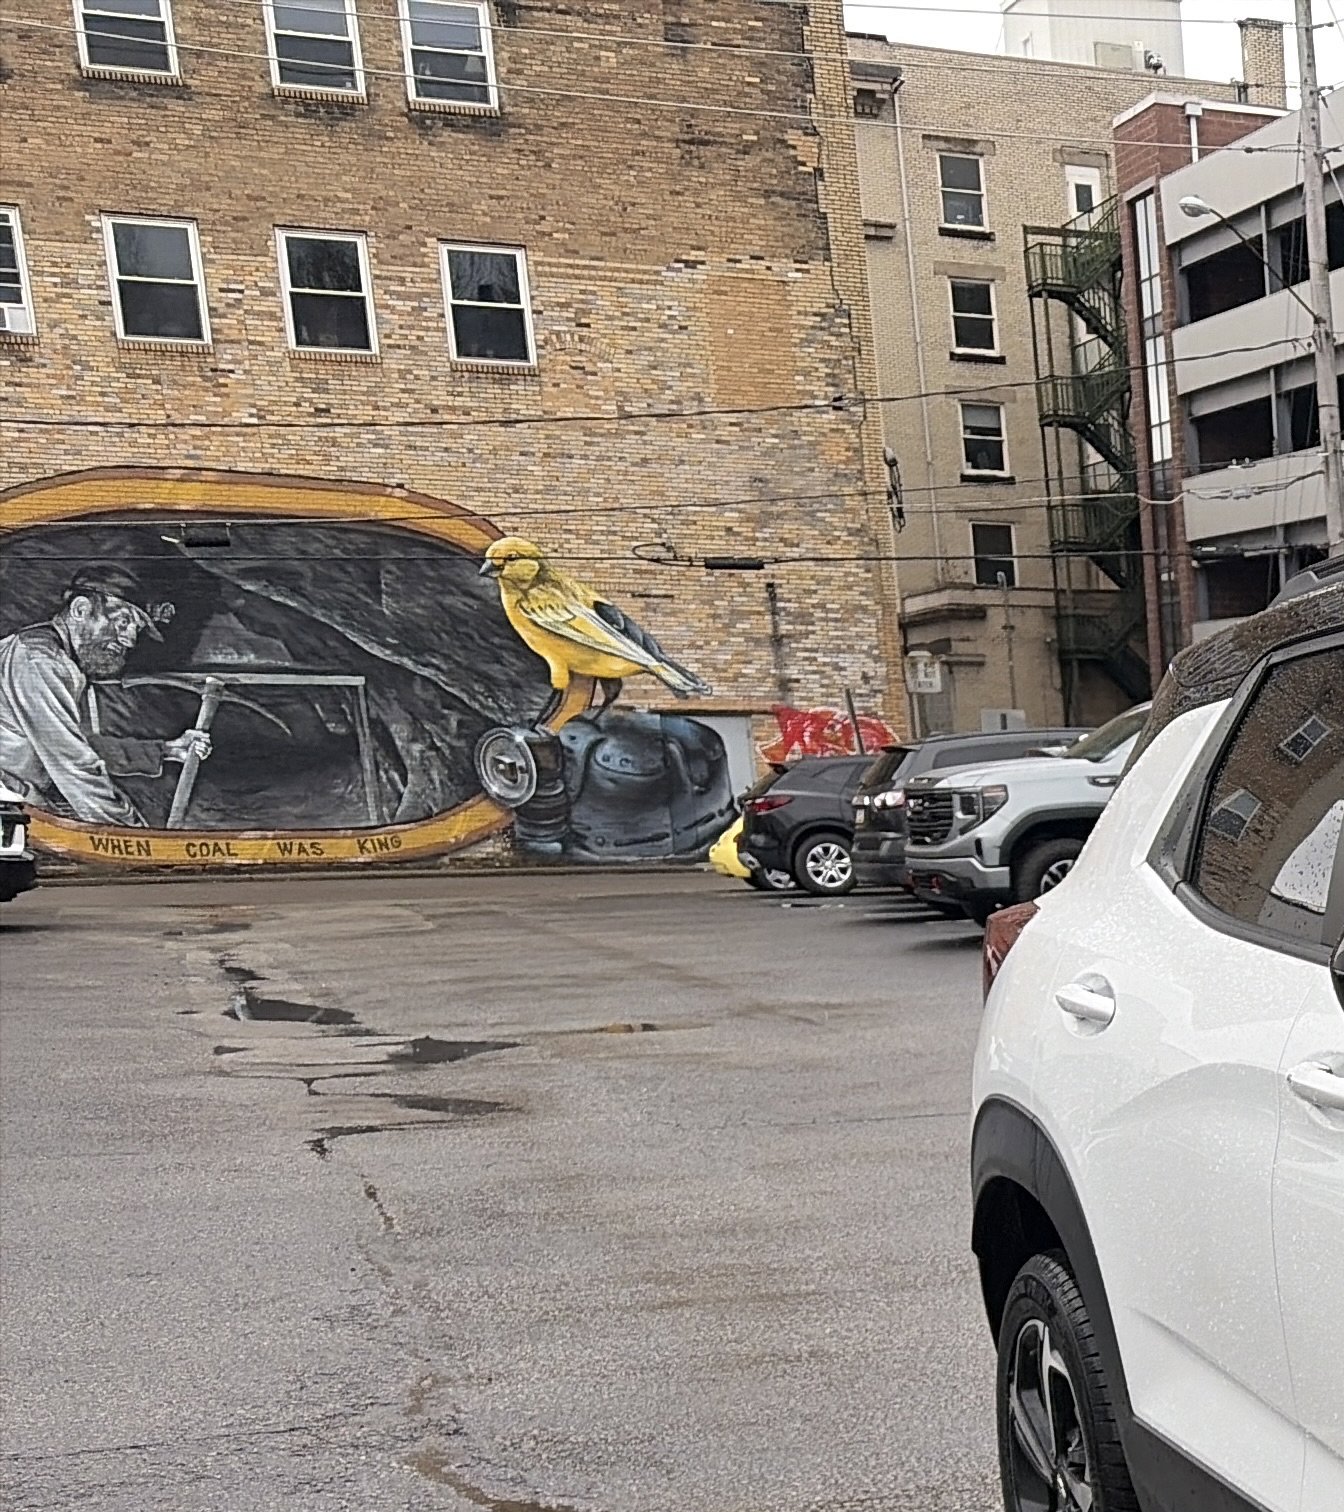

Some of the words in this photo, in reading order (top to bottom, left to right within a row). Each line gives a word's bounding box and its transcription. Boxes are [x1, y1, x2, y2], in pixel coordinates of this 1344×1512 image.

[89, 835, 153, 857] WHEN
[185, 841, 239, 858] COAL
[277, 841, 325, 857] WAS
[356, 834, 403, 854] KING
